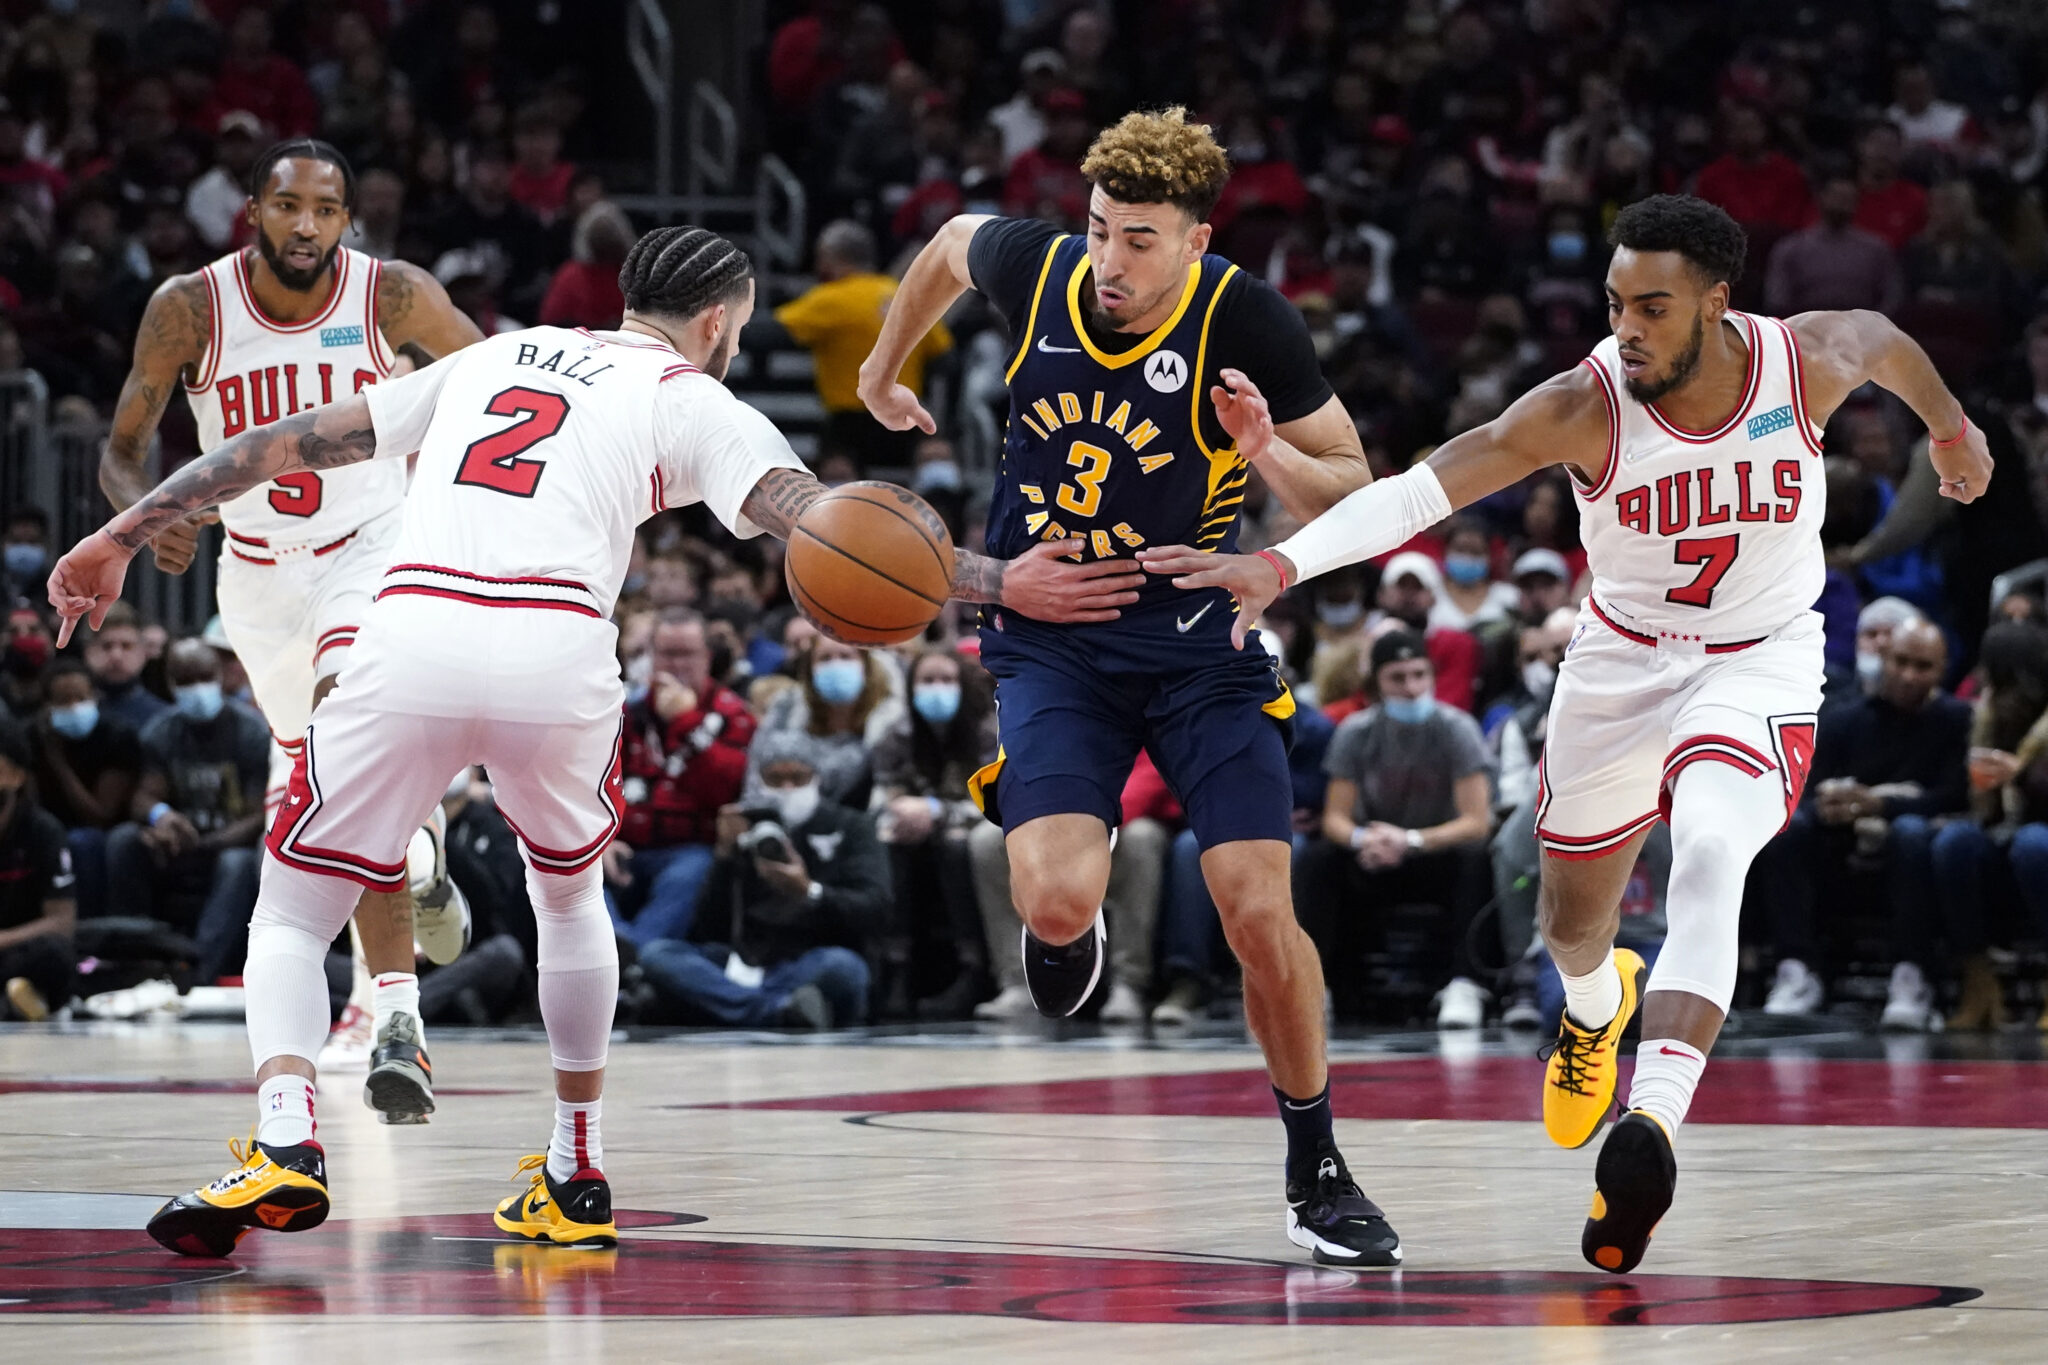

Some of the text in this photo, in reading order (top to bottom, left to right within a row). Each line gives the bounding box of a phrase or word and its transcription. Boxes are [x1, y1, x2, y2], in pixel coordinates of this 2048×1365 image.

[322, 326, 362, 339] ZENNI
[515, 343, 615, 387] BALL
[453, 385, 571, 498] 2
[1021, 390, 1175, 475] INDIANA
[1748, 406, 1791, 431] ZENNI
[1750, 419, 1793, 439] EYEWEAR
[1055, 440, 1112, 518] 3
[1616, 459, 1802, 537] BULLS
[1665, 533, 1741, 609] 7
